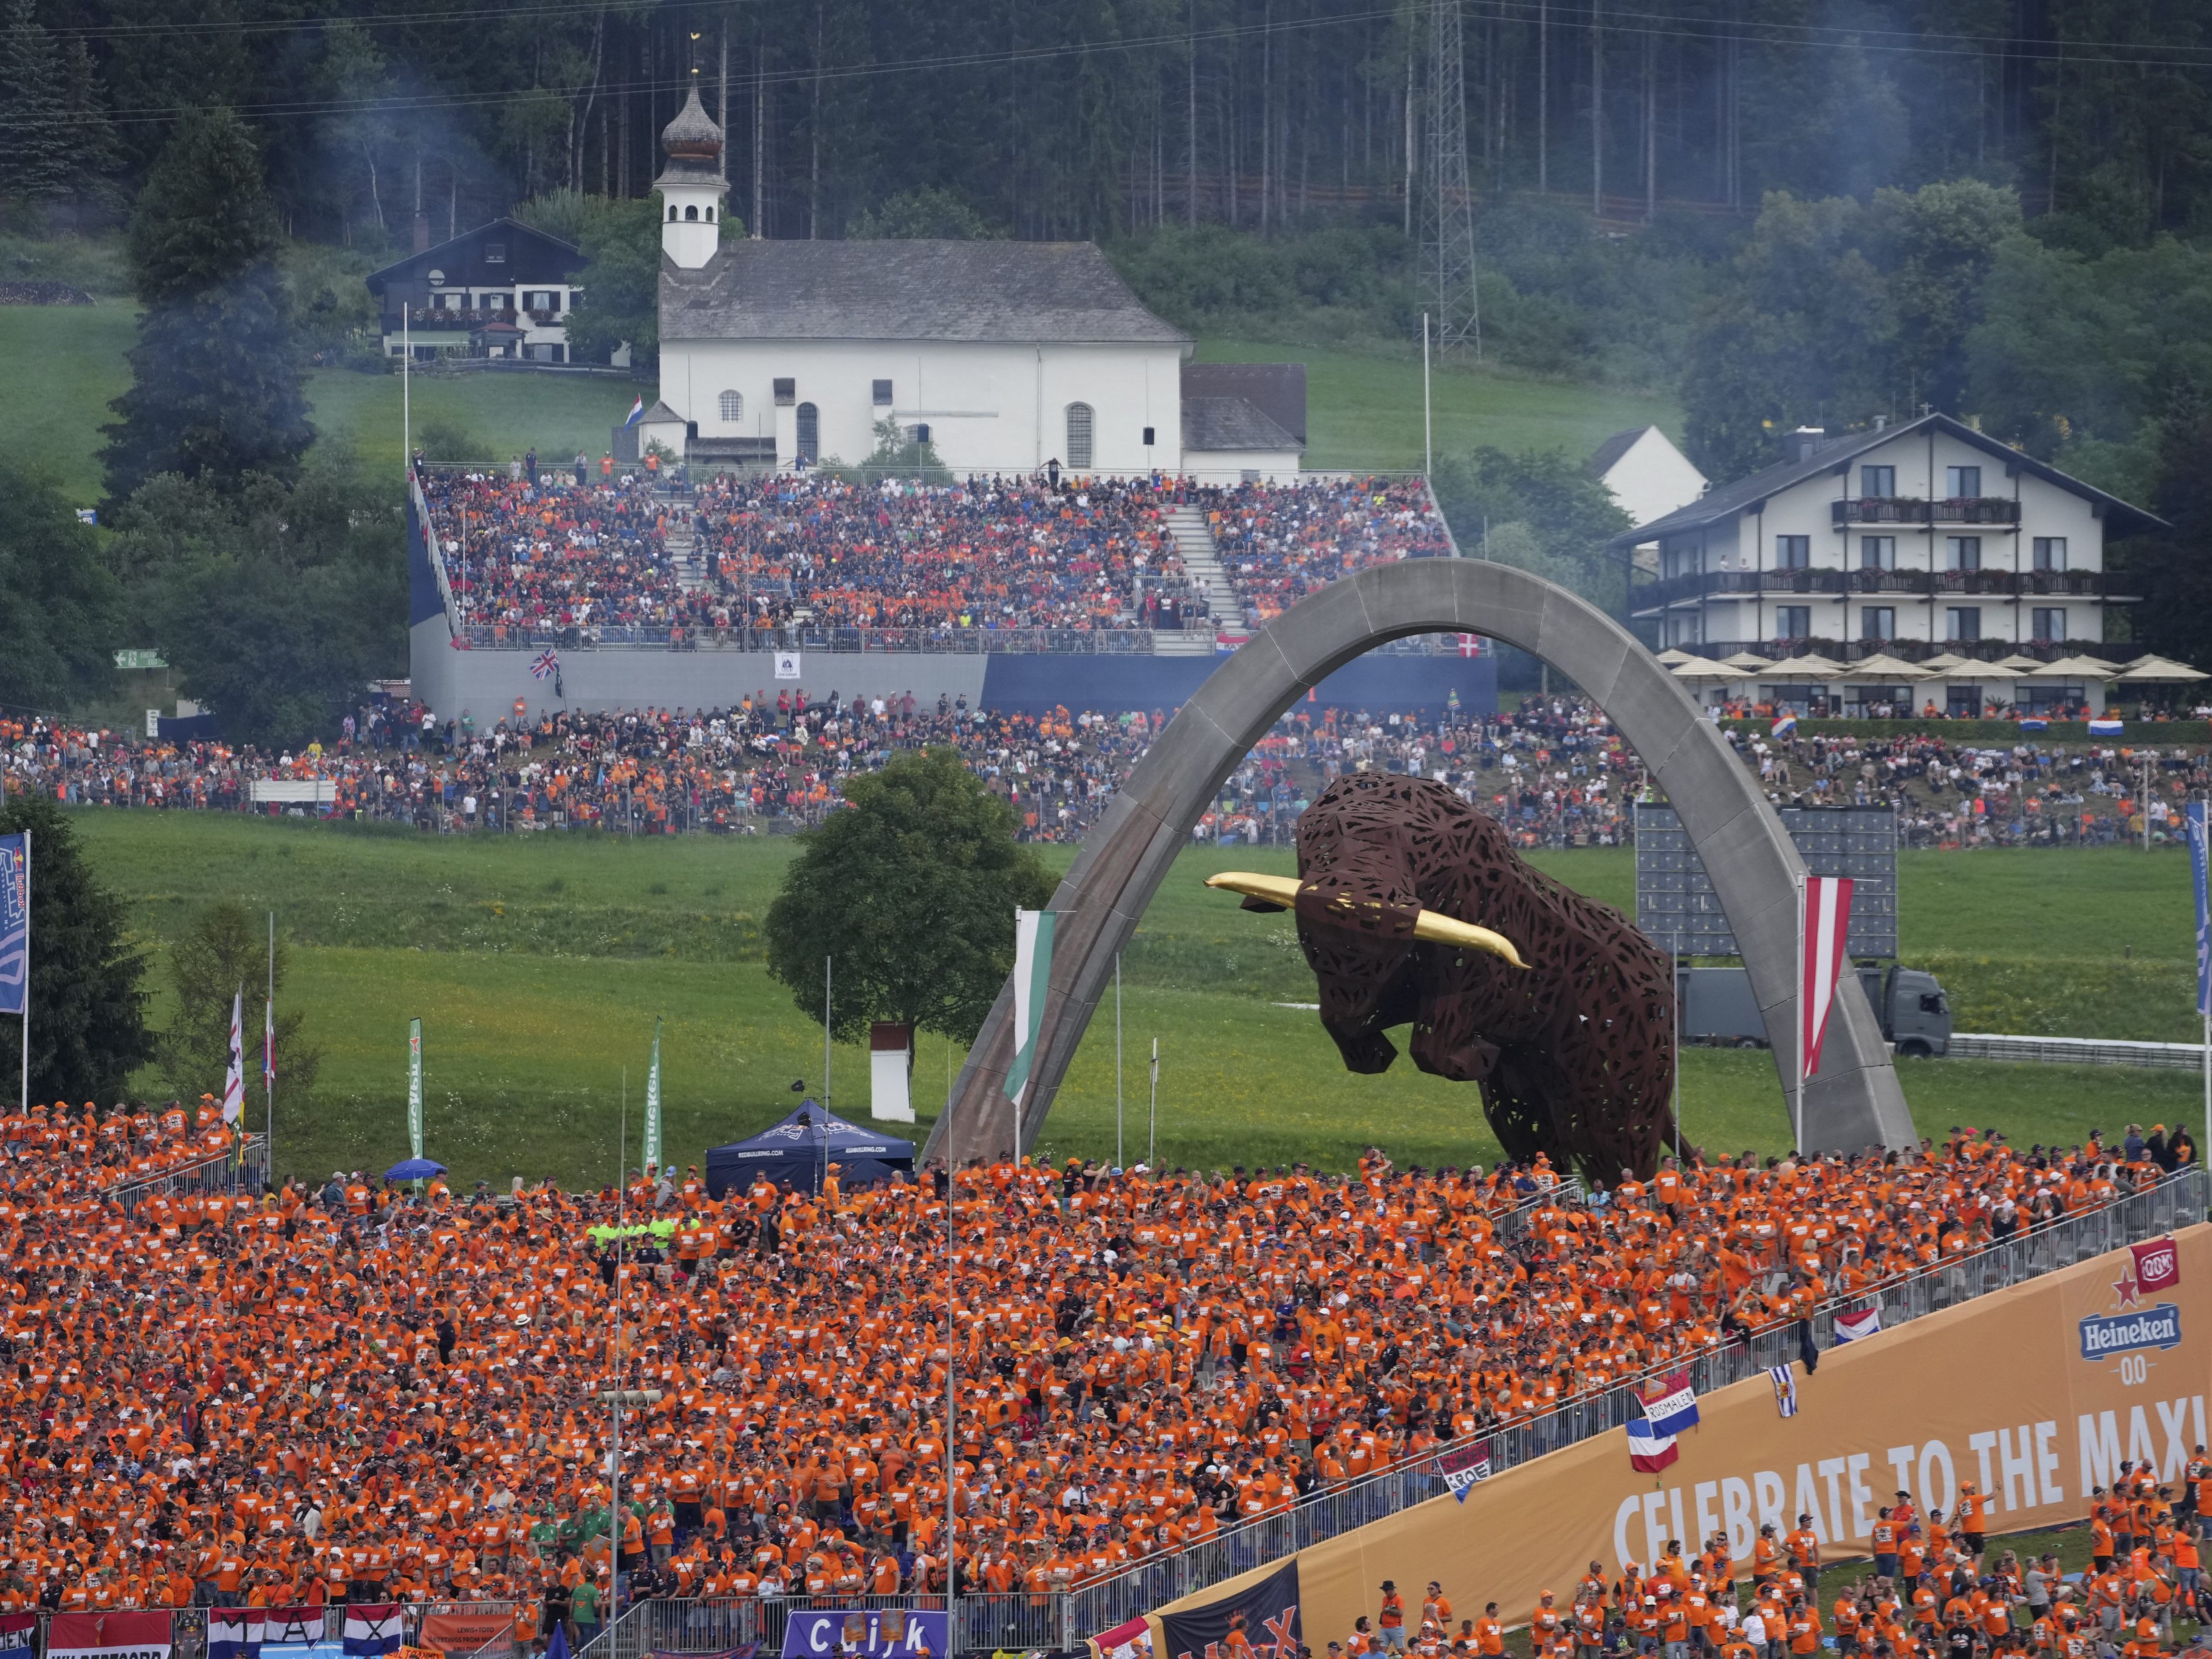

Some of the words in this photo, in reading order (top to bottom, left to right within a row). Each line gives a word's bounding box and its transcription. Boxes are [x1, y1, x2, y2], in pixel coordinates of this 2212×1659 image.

[2084, 1316, 2176, 1351] Heineken
[2120, 1354, 2147, 1386] 0.0
[1648, 1392, 1694, 1418] ROSMALEN
[1614, 1452, 1877, 1580] CELEBRATE
[1887, 1440, 1956, 1526] TO
[1968, 1420, 2064, 1516] THE
